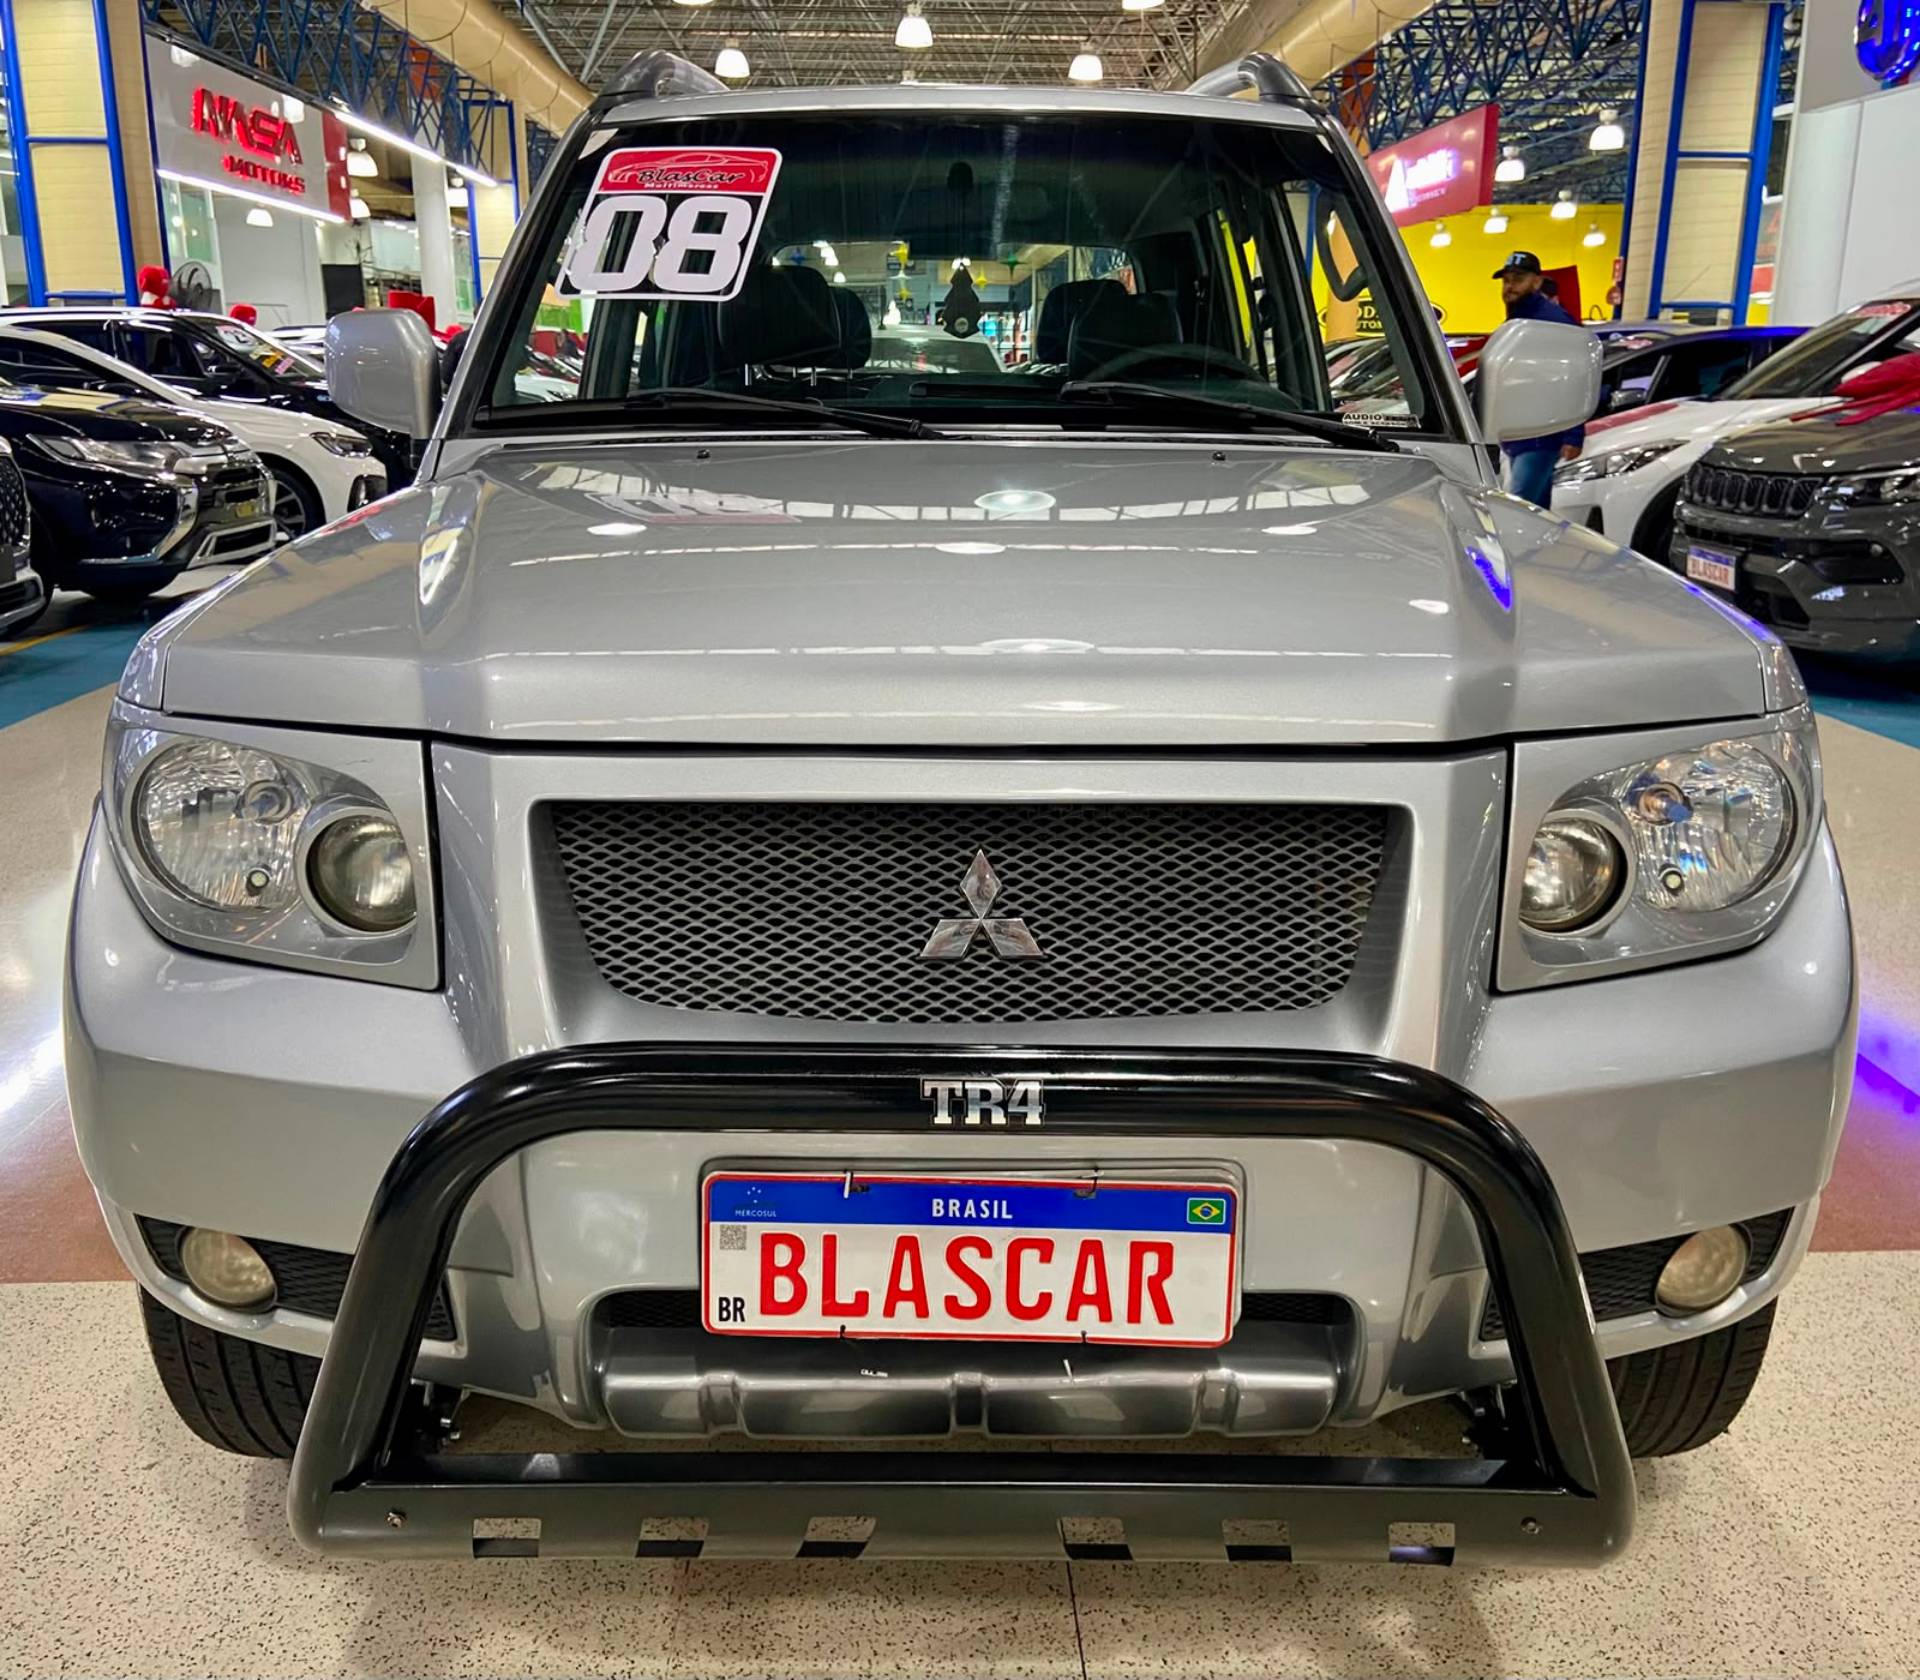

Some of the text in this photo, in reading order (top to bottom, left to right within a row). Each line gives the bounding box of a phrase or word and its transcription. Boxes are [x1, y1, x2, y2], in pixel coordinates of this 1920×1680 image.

[222, 155, 305, 194] MOTORS
[637, 168, 746, 184] BlasCar
[567, 195, 752, 293] 08
[1344, 413, 1382, 421] AUDIO
[923, 1080, 1043, 1125] TR4
[735, 1209, 777, 1218] MERCOSUL
[932, 1198, 1013, 1219] BRASIL
[760, 1232, 1175, 1325] BLASCAR
[718, 1296, 746, 1322] BR
